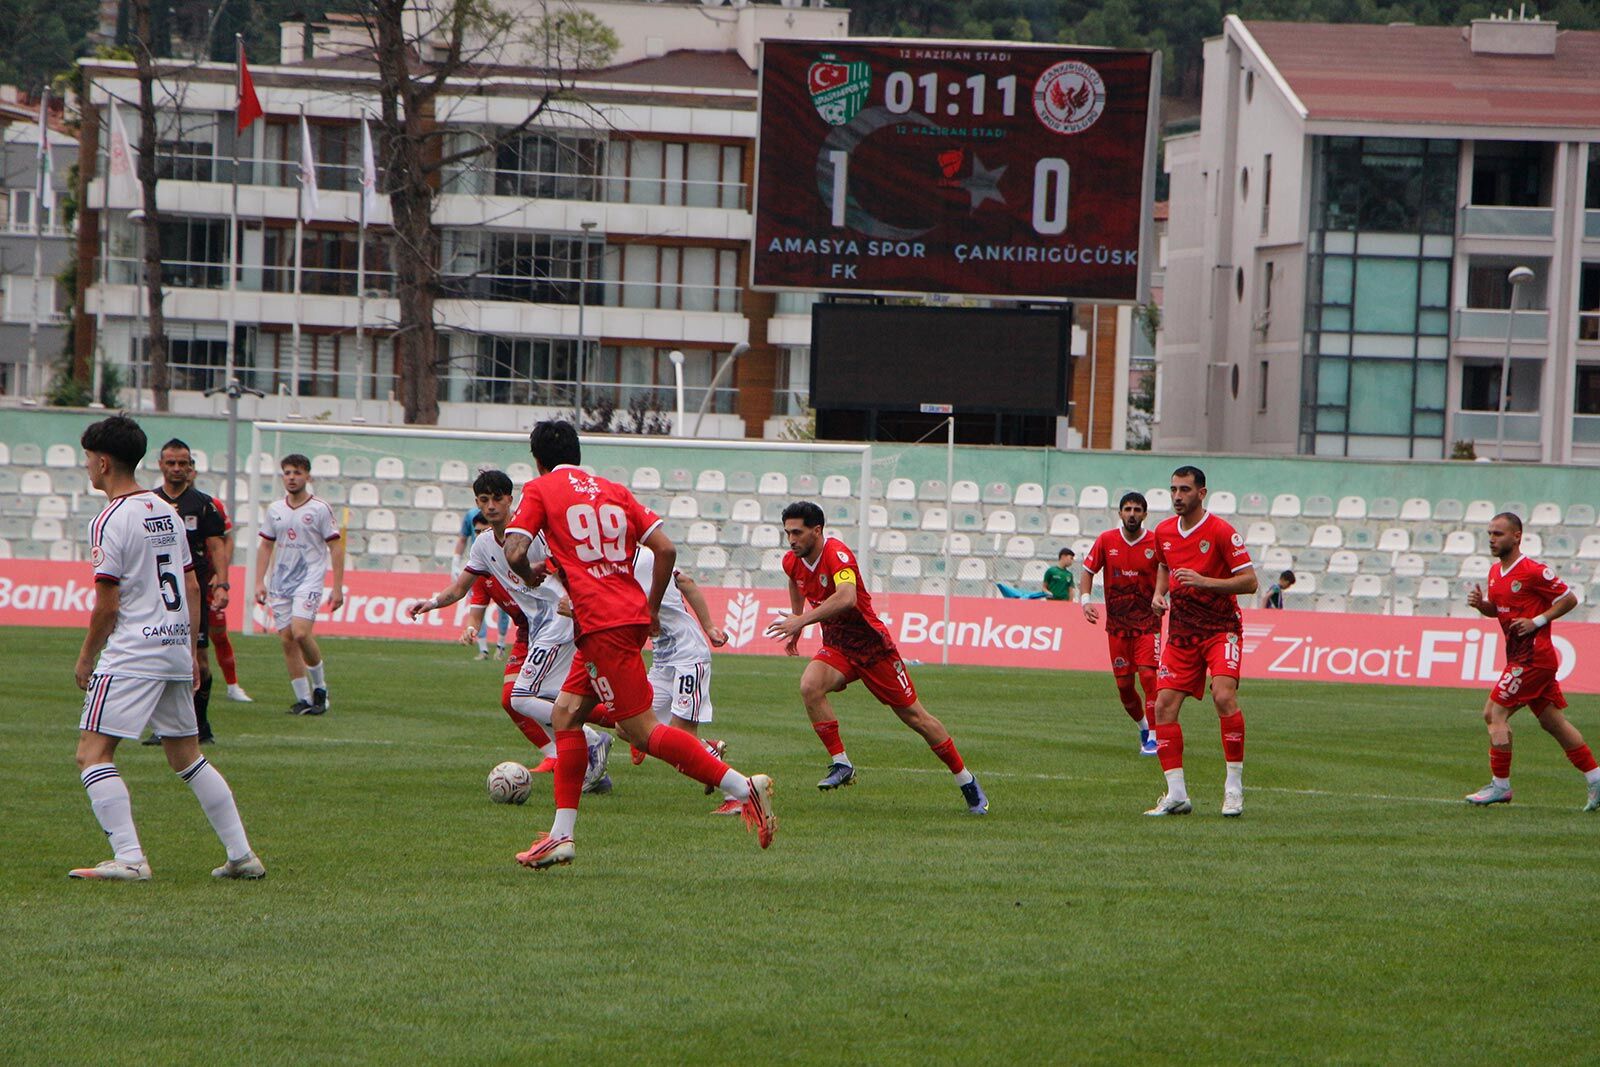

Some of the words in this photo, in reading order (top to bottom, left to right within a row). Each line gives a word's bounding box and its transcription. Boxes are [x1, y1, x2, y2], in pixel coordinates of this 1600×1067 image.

[900, 49, 911, 59] 12
[884, 71, 1017, 117] 01:11
[828, 150, 848, 227] 1
[1031, 157, 1071, 235] 0
[768, 237, 860, 256] AMASYA
[867, 241, 926, 258] SPOR
[954, 244, 1138, 265] ÇANKIRIGÜCÜSK
[831, 263, 857, 280] FK
[566, 504, 628, 562] 99
[156, 553, 183, 612] 5
[839, 569, 850, 581] C
[899, 612, 1063, 652] Bankası
[527, 646, 547, 666] 10
[1224, 642, 1240, 662] 16
[1267, 635, 1413, 679] Ziraat
[678, 674, 695, 695] 19
[896, 670, 909, 689] 17
[1498, 672, 1522, 694] 26
